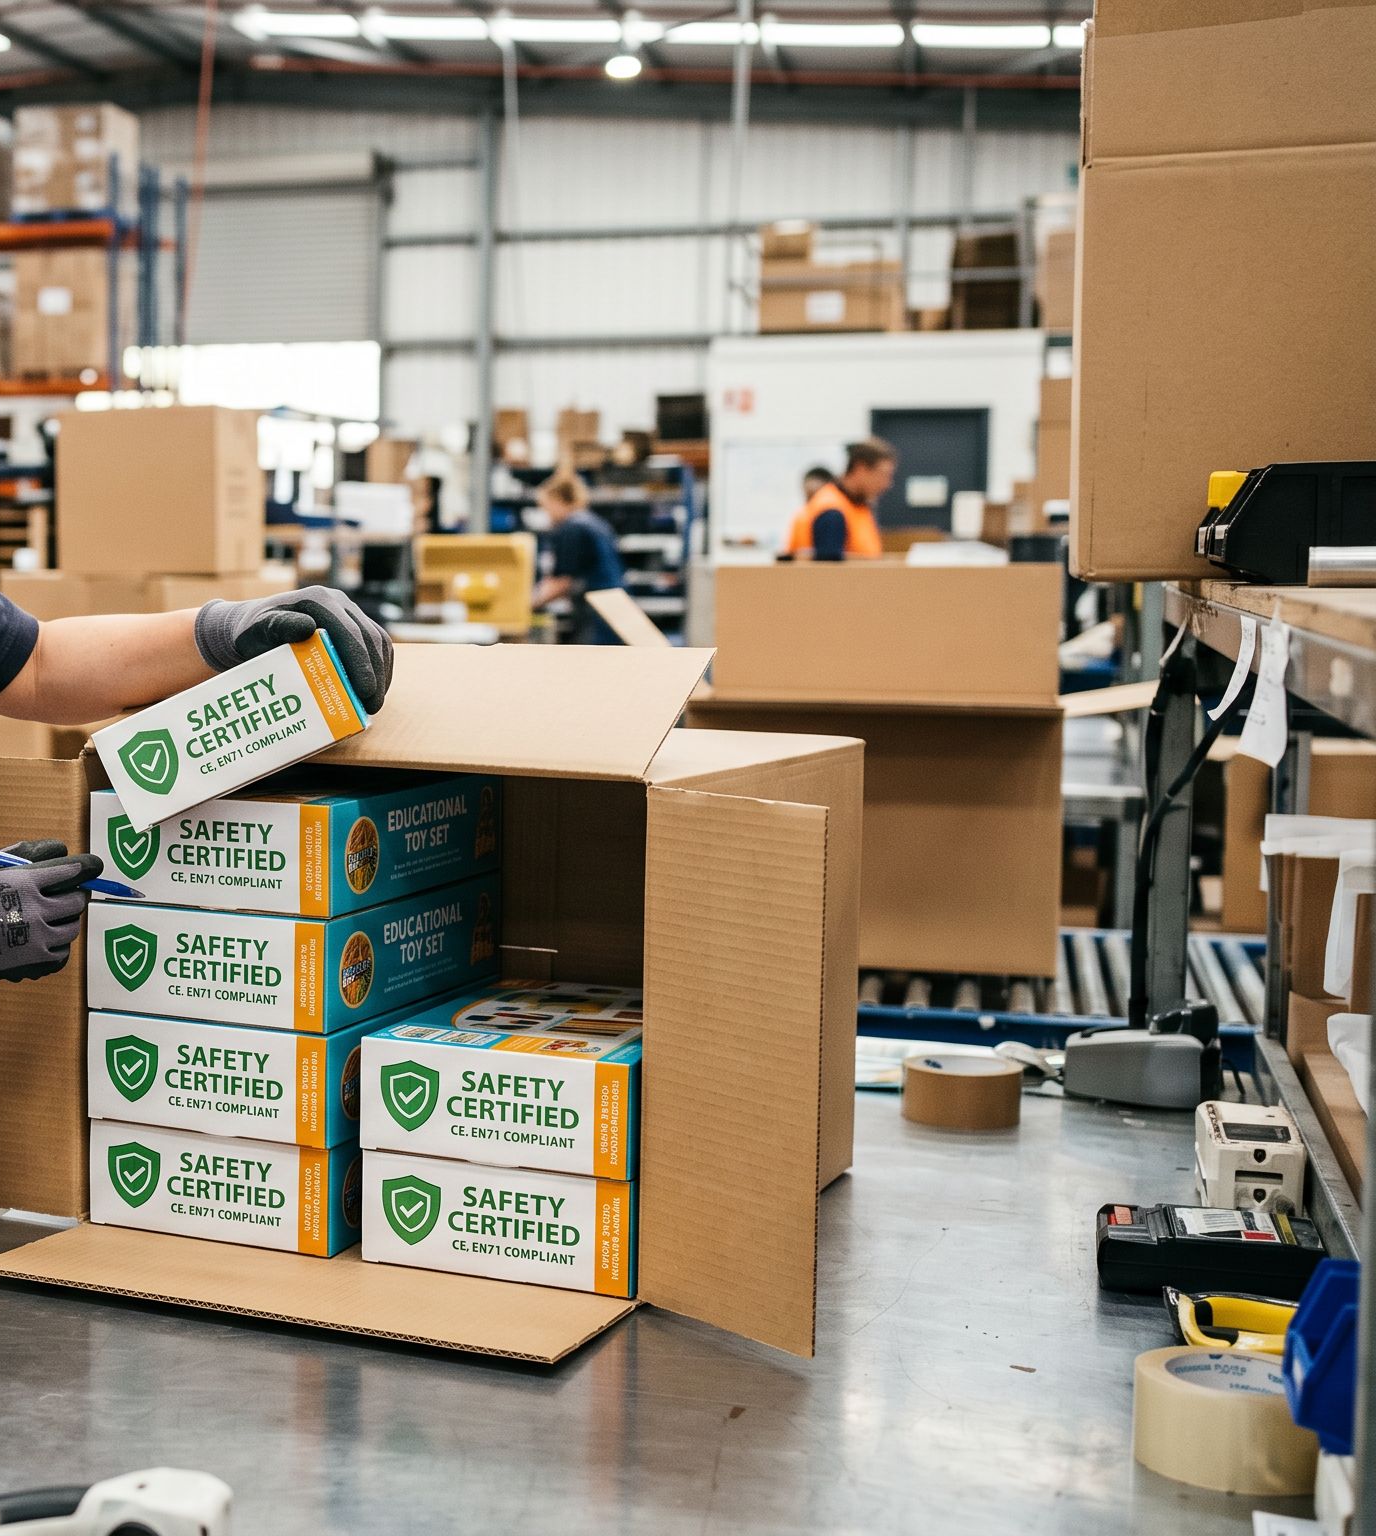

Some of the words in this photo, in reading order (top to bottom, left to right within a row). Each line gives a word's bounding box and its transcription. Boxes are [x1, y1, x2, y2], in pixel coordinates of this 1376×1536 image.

[186, 673, 276, 732] SAFETY
[185, 694, 302, 759] CERTIFIED
[200, 762, 217, 775] CE,
[216, 749, 244, 768] EN71
[245, 718, 307, 754] COMPLIANT
[387, 794, 468, 832] EDUCATIONAL
[179, 818, 274, 845] SAFETY
[404, 831, 428, 853] TOY
[429, 823, 450, 848] SET
[166, 843, 287, 872] CERTIFIED
[170, 871, 187, 884] CE,
[189, 872, 215, 885] EN71
[217, 875, 283, 890] COMPLIANT
[383, 902, 463, 945] EDUCATIONAL
[175, 932, 269, 961] SAFETY
[399, 940, 424, 965] TOY
[425, 931, 445, 957] SET
[163, 956, 282, 988] CERTIFIED
[186, 986, 211, 999] EN71
[214, 989, 278, 1006] COMPLIANT
[177, 1044, 270, 1074] SAFETY
[164, 1068, 284, 1101] CERTIFIED
[461, 1070, 565, 1102] SAFETY
[186, 1097, 212, 1111] EN71
[215, 1101, 280, 1119] COMPLIANT
[446, 1095, 580, 1130] CERTIFIED
[471, 1126, 500, 1141] EN71
[503, 1130, 575, 1149] COMPLIANT
[179, 1151, 273, 1183] SAFETY
[166, 1175, 286, 1209] CERTIFIED
[462, 1186, 566, 1219] SAFETY
[188, 1205, 215, 1218] EN71
[217, 1209, 282, 1227] COMPLIANT
[447, 1210, 581, 1247] CERTIFIED
[452, 1239, 470, 1253] CE,
[472, 1241, 501, 1256] EN71
[504, 1246, 576, 1266] COMPLIANT
